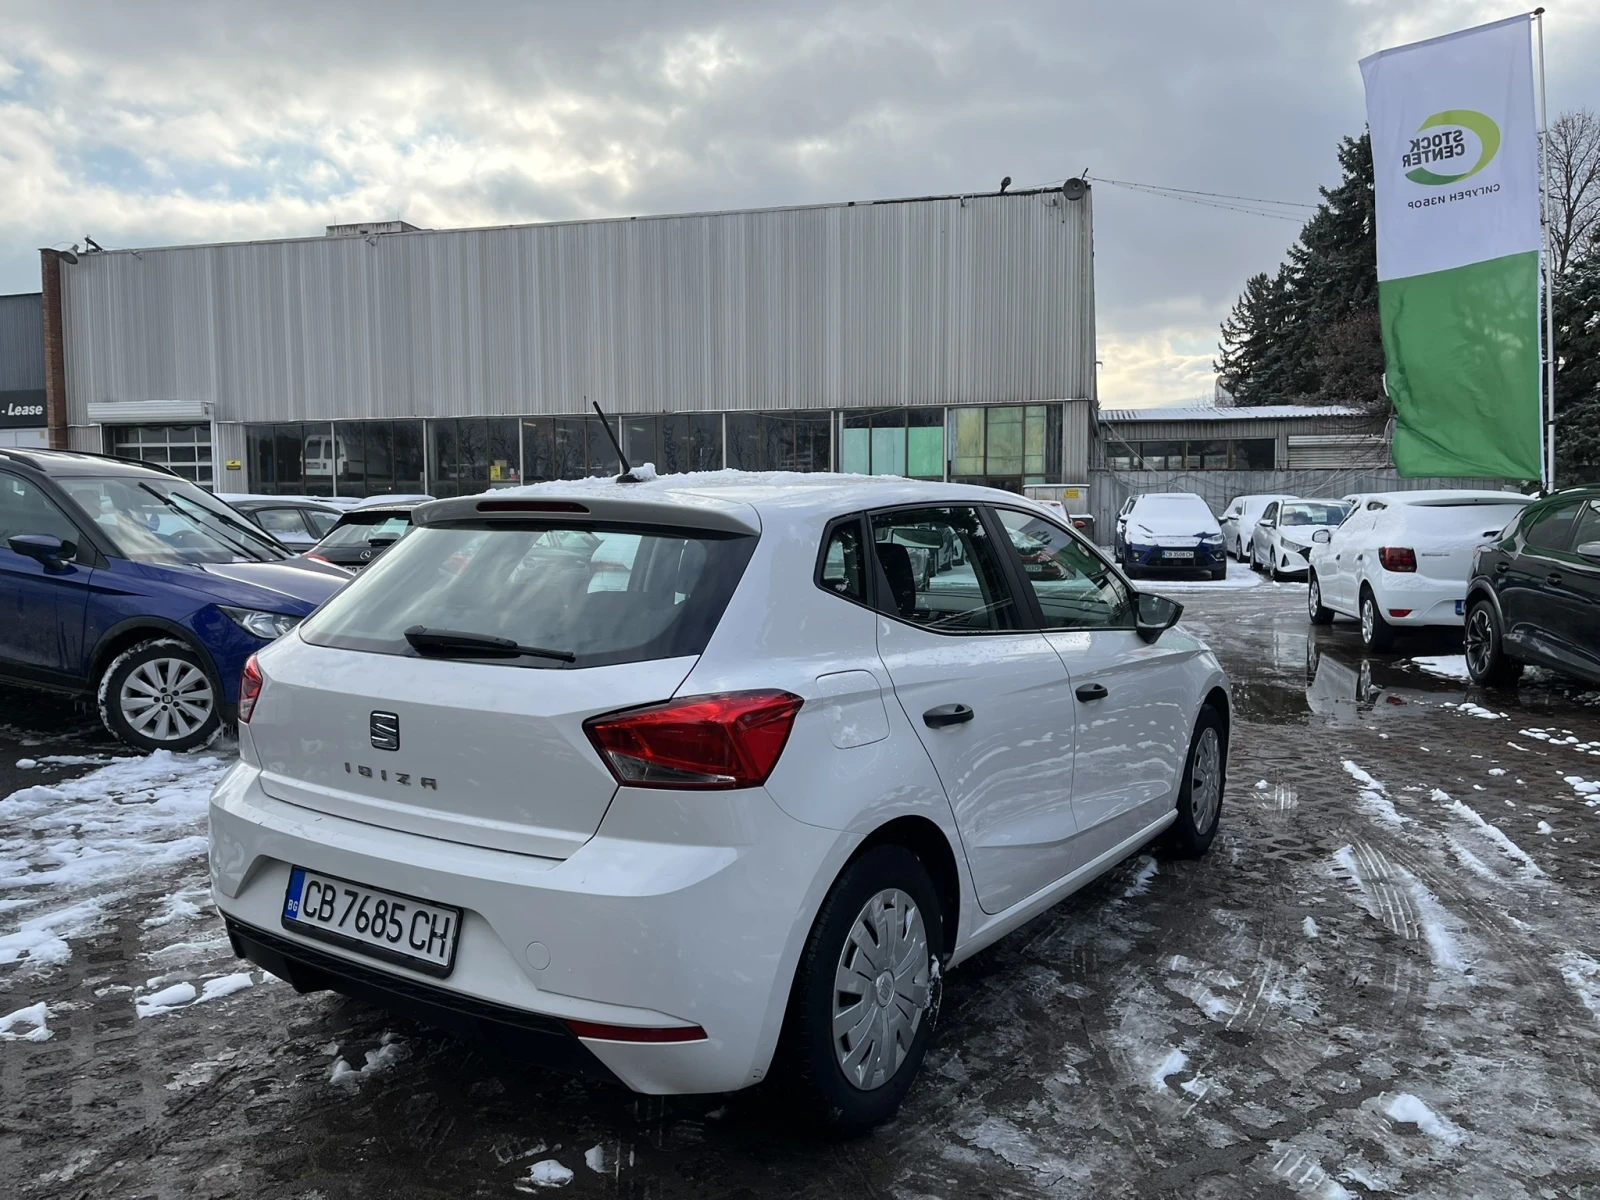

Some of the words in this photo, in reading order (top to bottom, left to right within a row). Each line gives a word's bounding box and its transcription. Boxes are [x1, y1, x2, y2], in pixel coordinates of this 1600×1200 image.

[8, 402, 43, 416] Lease
[344, 761, 437, 791] IBIZA
[287, 899, 299, 912] BG
[338, 889, 406, 943] 7685
